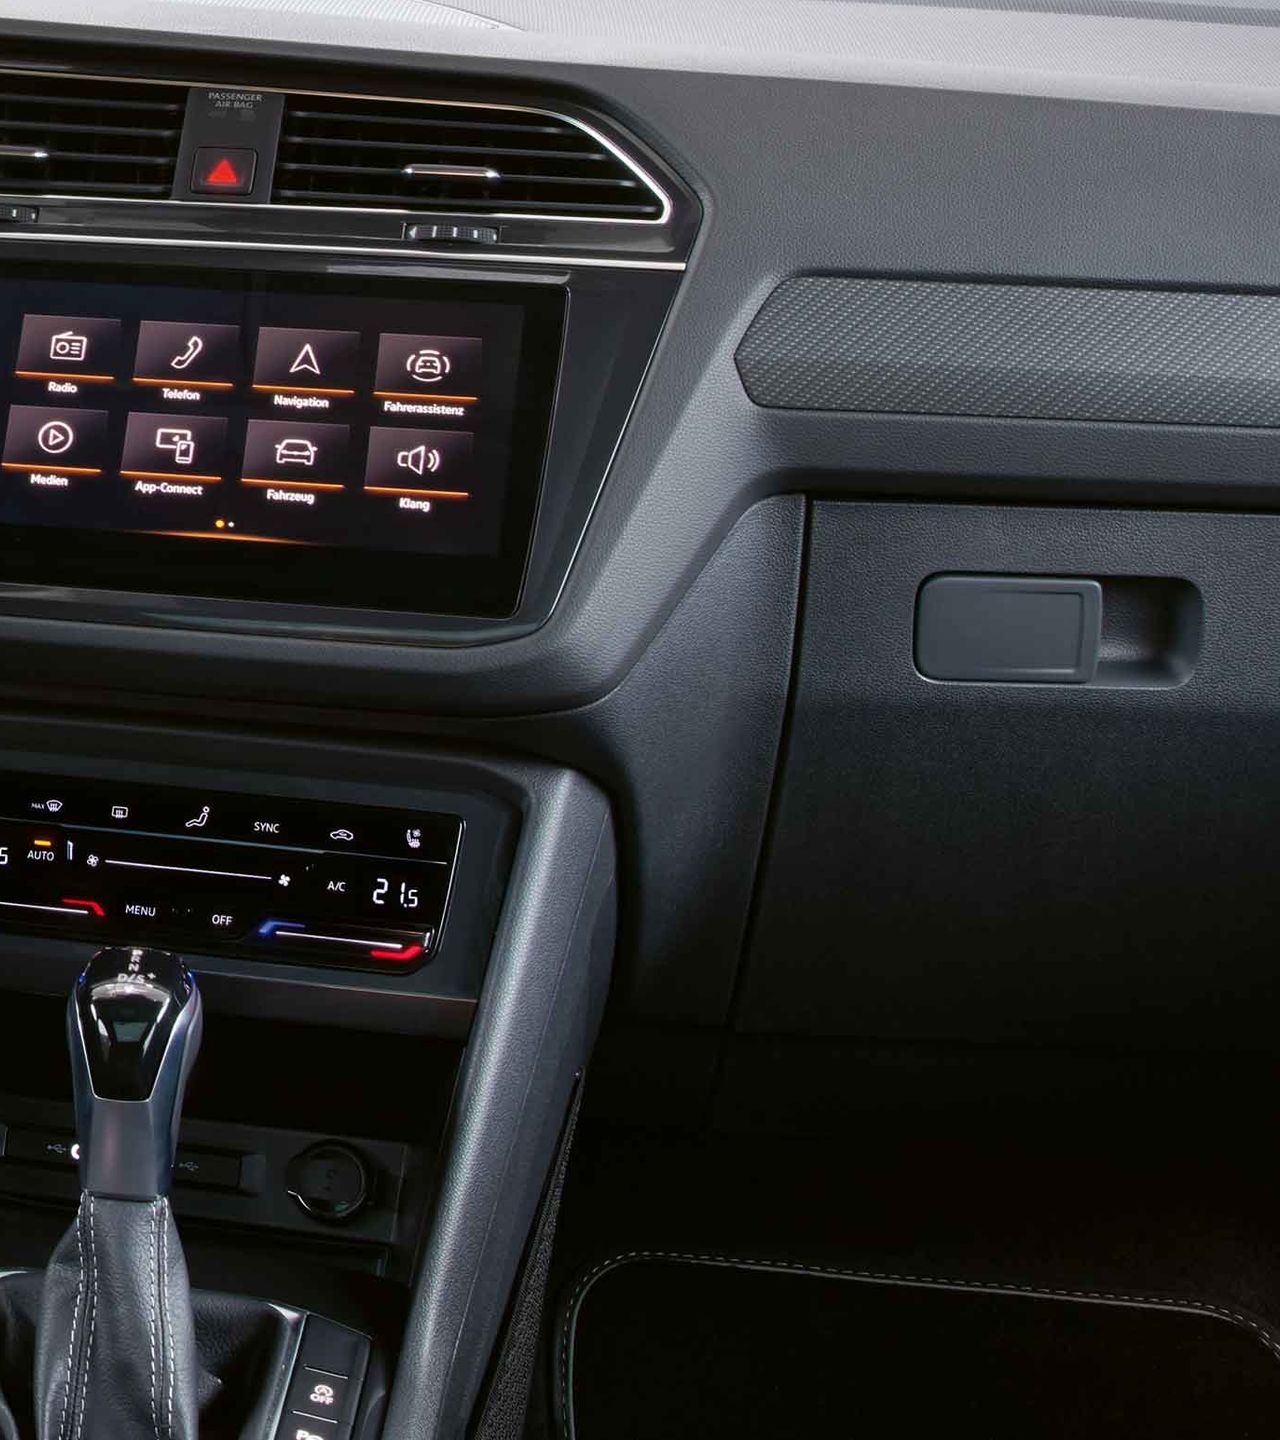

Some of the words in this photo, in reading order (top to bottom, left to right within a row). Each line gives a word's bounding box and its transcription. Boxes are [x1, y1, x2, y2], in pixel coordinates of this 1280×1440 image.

[208, 92, 263, 102] PASSENGER
[233, 101, 254, 109] BAG
[47, 380, 78, 395] Radio
[162, 387, 200, 401] Telefon
[273, 394, 330, 410] Navigation
[383, 400, 465, 416] Fahrerassistenz
[30, 472, 69, 487] Medien
[134, 480, 203, 497] App-Connect
[266, 488, 315, 505] Fahrzeug
[398, 497, 431, 512] Klang
[253, 822, 280, 834] SYNC
[26, 850, 55, 862] AUTO
[327, 880, 346, 892] A/C
[372, 878, 419, 909] 21.5
[125, 904, 157, 917] MENU
[211, 914, 233, 927] OFF
[309, 1393, 334, 1405] OFF
